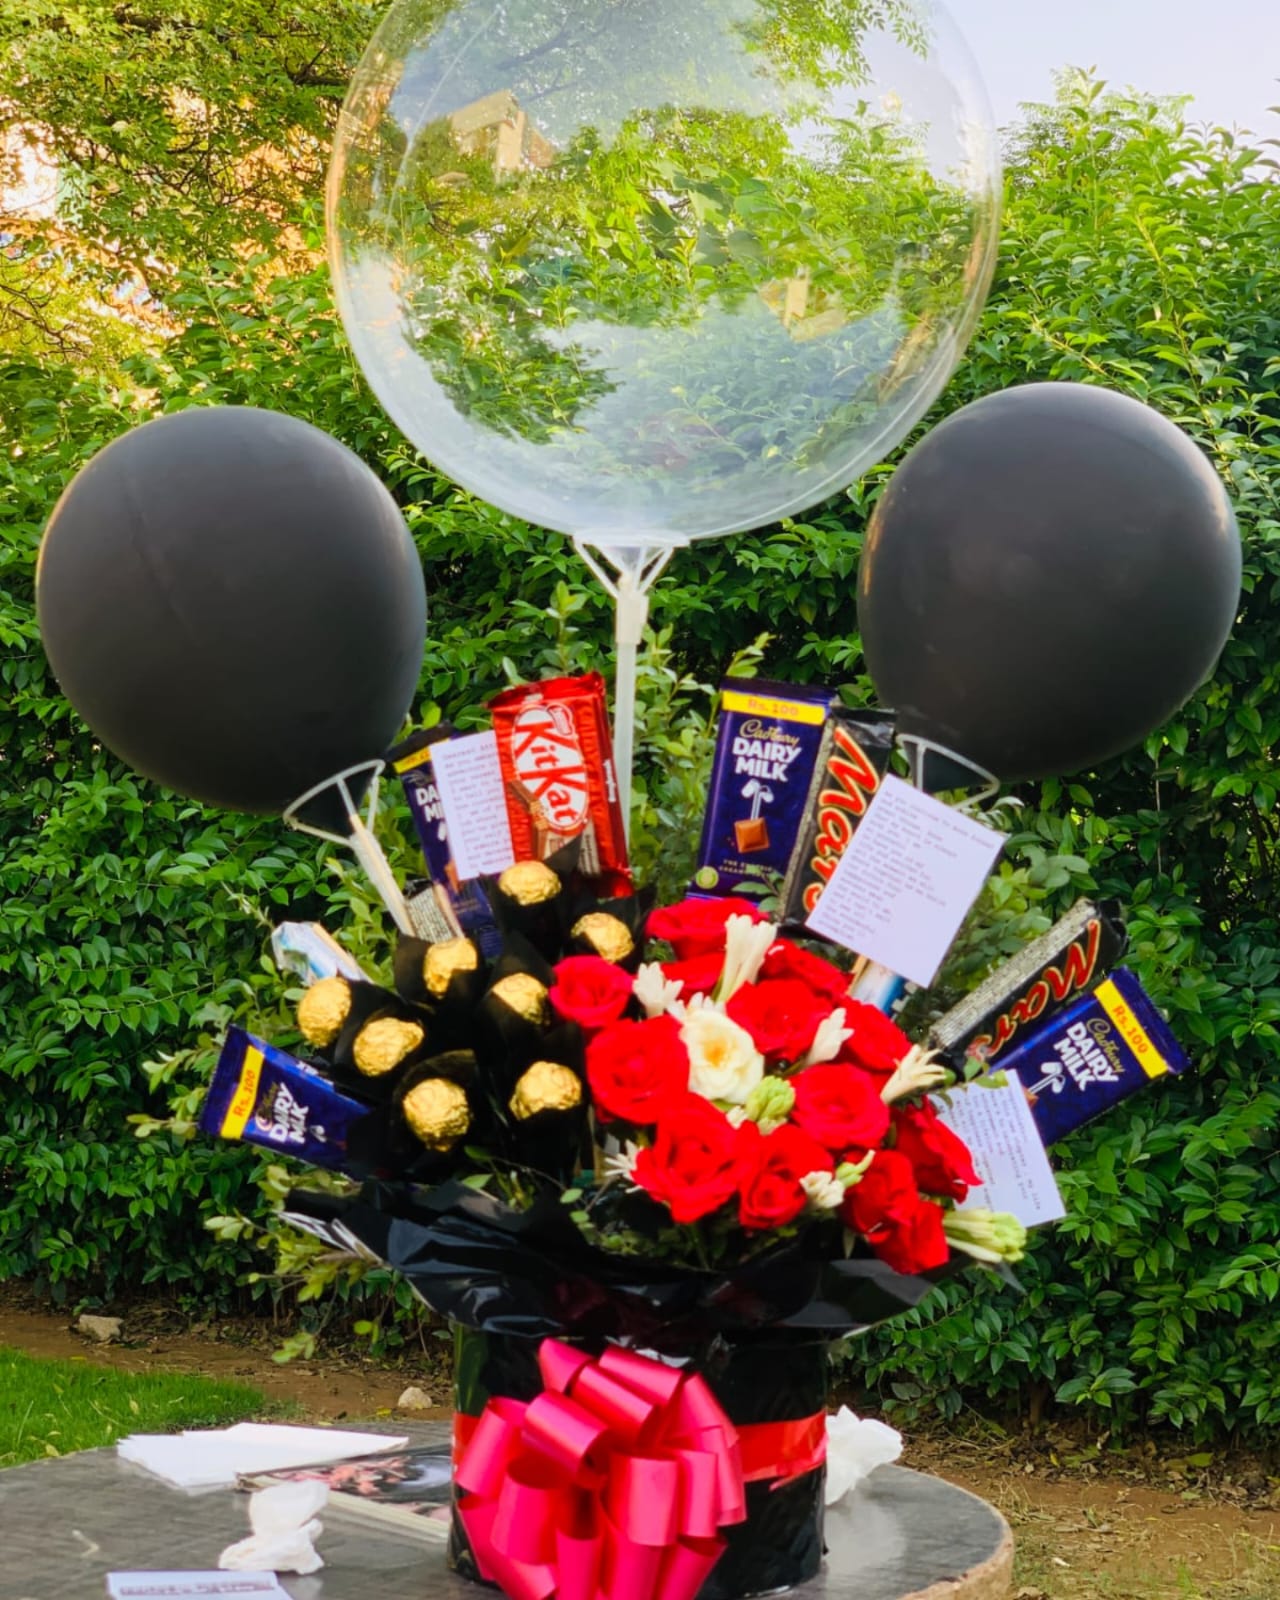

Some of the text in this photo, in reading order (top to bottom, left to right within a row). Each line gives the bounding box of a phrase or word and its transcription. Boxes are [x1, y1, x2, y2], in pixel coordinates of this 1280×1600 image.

[732, 736, 802, 763] DAIRY
[740, 719, 800, 746] Cadbury
[735, 755, 788, 782] MILK
[965, 919, 1101, 1062] Mars
[1053, 1036, 1097, 1092] MILK
[1066, 1021, 1119, 1082] DAIRY
[1086, 1017, 1126, 1073] Cadbury
